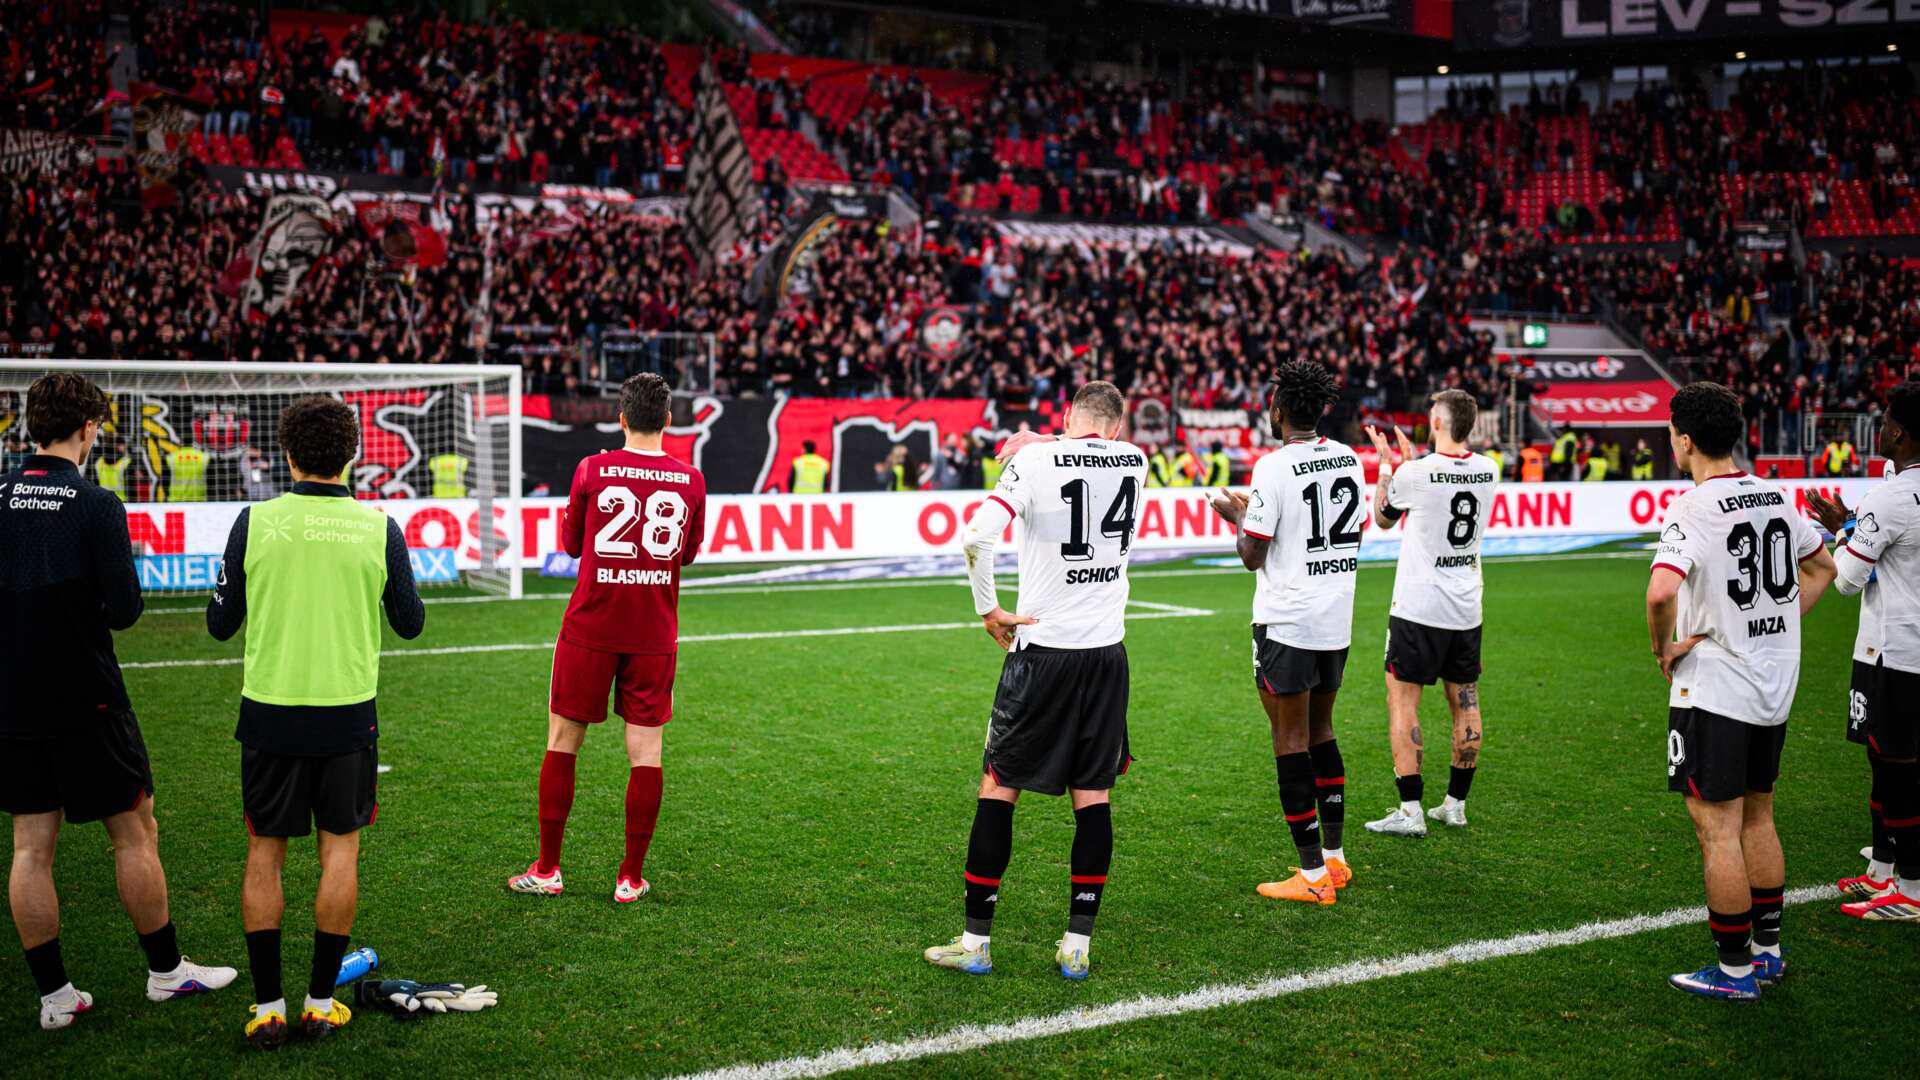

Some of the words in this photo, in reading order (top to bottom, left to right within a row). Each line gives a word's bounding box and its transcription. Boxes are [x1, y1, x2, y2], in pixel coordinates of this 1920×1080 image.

[1562, 0, 1709, 37] LEV
[1054, 455, 1143, 468] LEVERKUSEN
[1292, 455, 1358, 477] LEVERKUSEN
[600, 466, 690, 485] LEVERKUSEN
[1430, 472, 1493, 484] LEVERKUSEN
[12, 483, 77, 499] Barmenia
[9, 497, 64, 512] Gothaer
[1718, 491, 1785, 514] LEVERKUSEN
[304, 514, 375, 533] Barmenia
[594, 486, 689, 561] 28
[1060, 476, 1140, 562] 14
[1302, 476, 1360, 553] 12
[1447, 491, 1481, 549] 8
[304, 529, 365, 545] Gothaer
[1065, 564, 1121, 584] SCHICK
[1306, 558, 1358, 576] TAPSOB
[1727, 517, 1799, 611] 30
[597, 568, 672, 585] BLASWICH
[1748, 616, 1787, 638] MAZA
